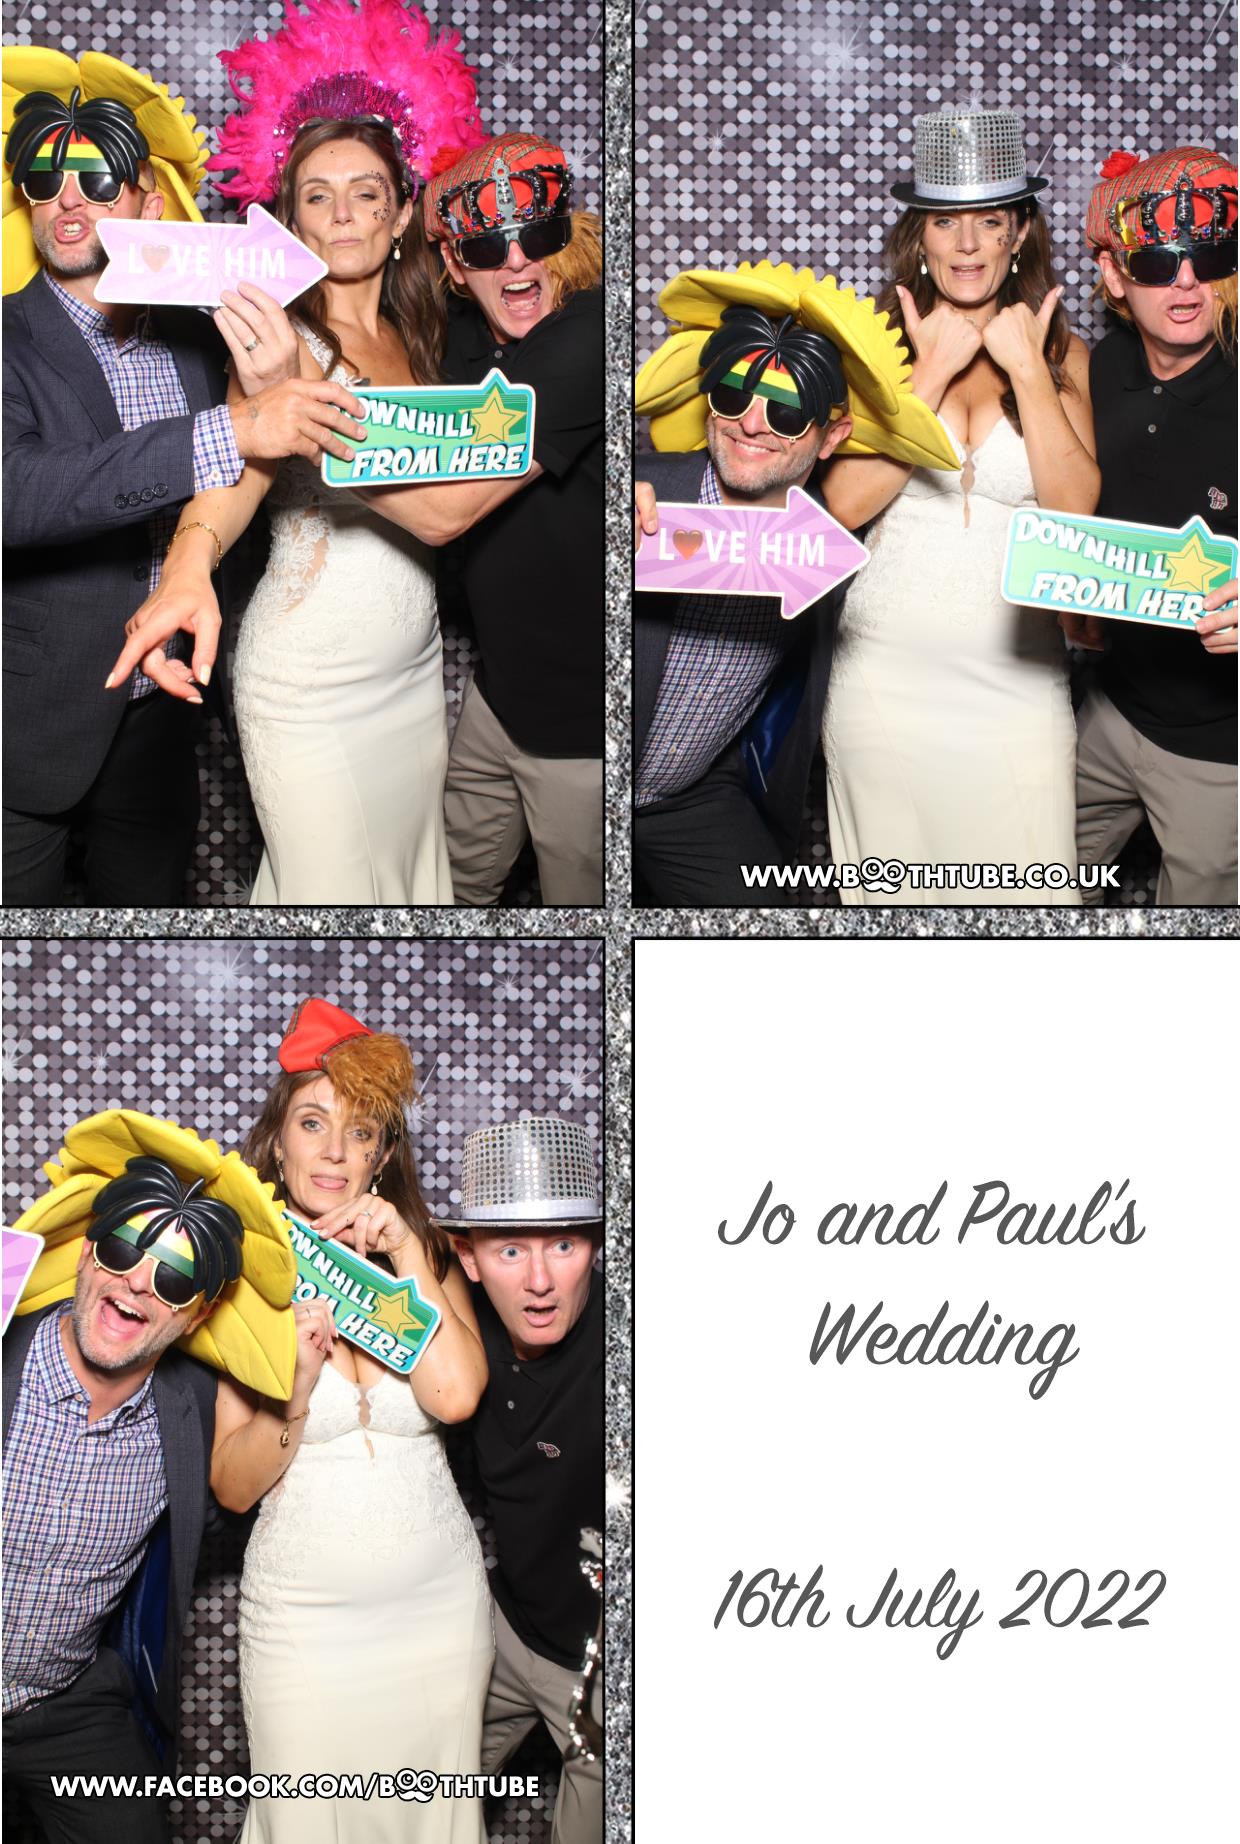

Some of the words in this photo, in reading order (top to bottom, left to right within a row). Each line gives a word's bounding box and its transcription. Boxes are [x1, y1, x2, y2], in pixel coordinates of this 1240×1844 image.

[224, 246, 286, 279] HIM
[347, 396, 474, 438] OWNHILL
[352, 446, 439, 478] FROM
[448, 443, 525, 474] HERE
[760, 532, 825, 567] HIM
[1015, 513, 1170, 580] DOWNHILL
[1031, 571, 1128, 611] FROM
[1136, 588, 1227, 626] HER
[281, 1213, 377, 1313] OWNHILL
[339, 1313, 414, 1367] HERE
